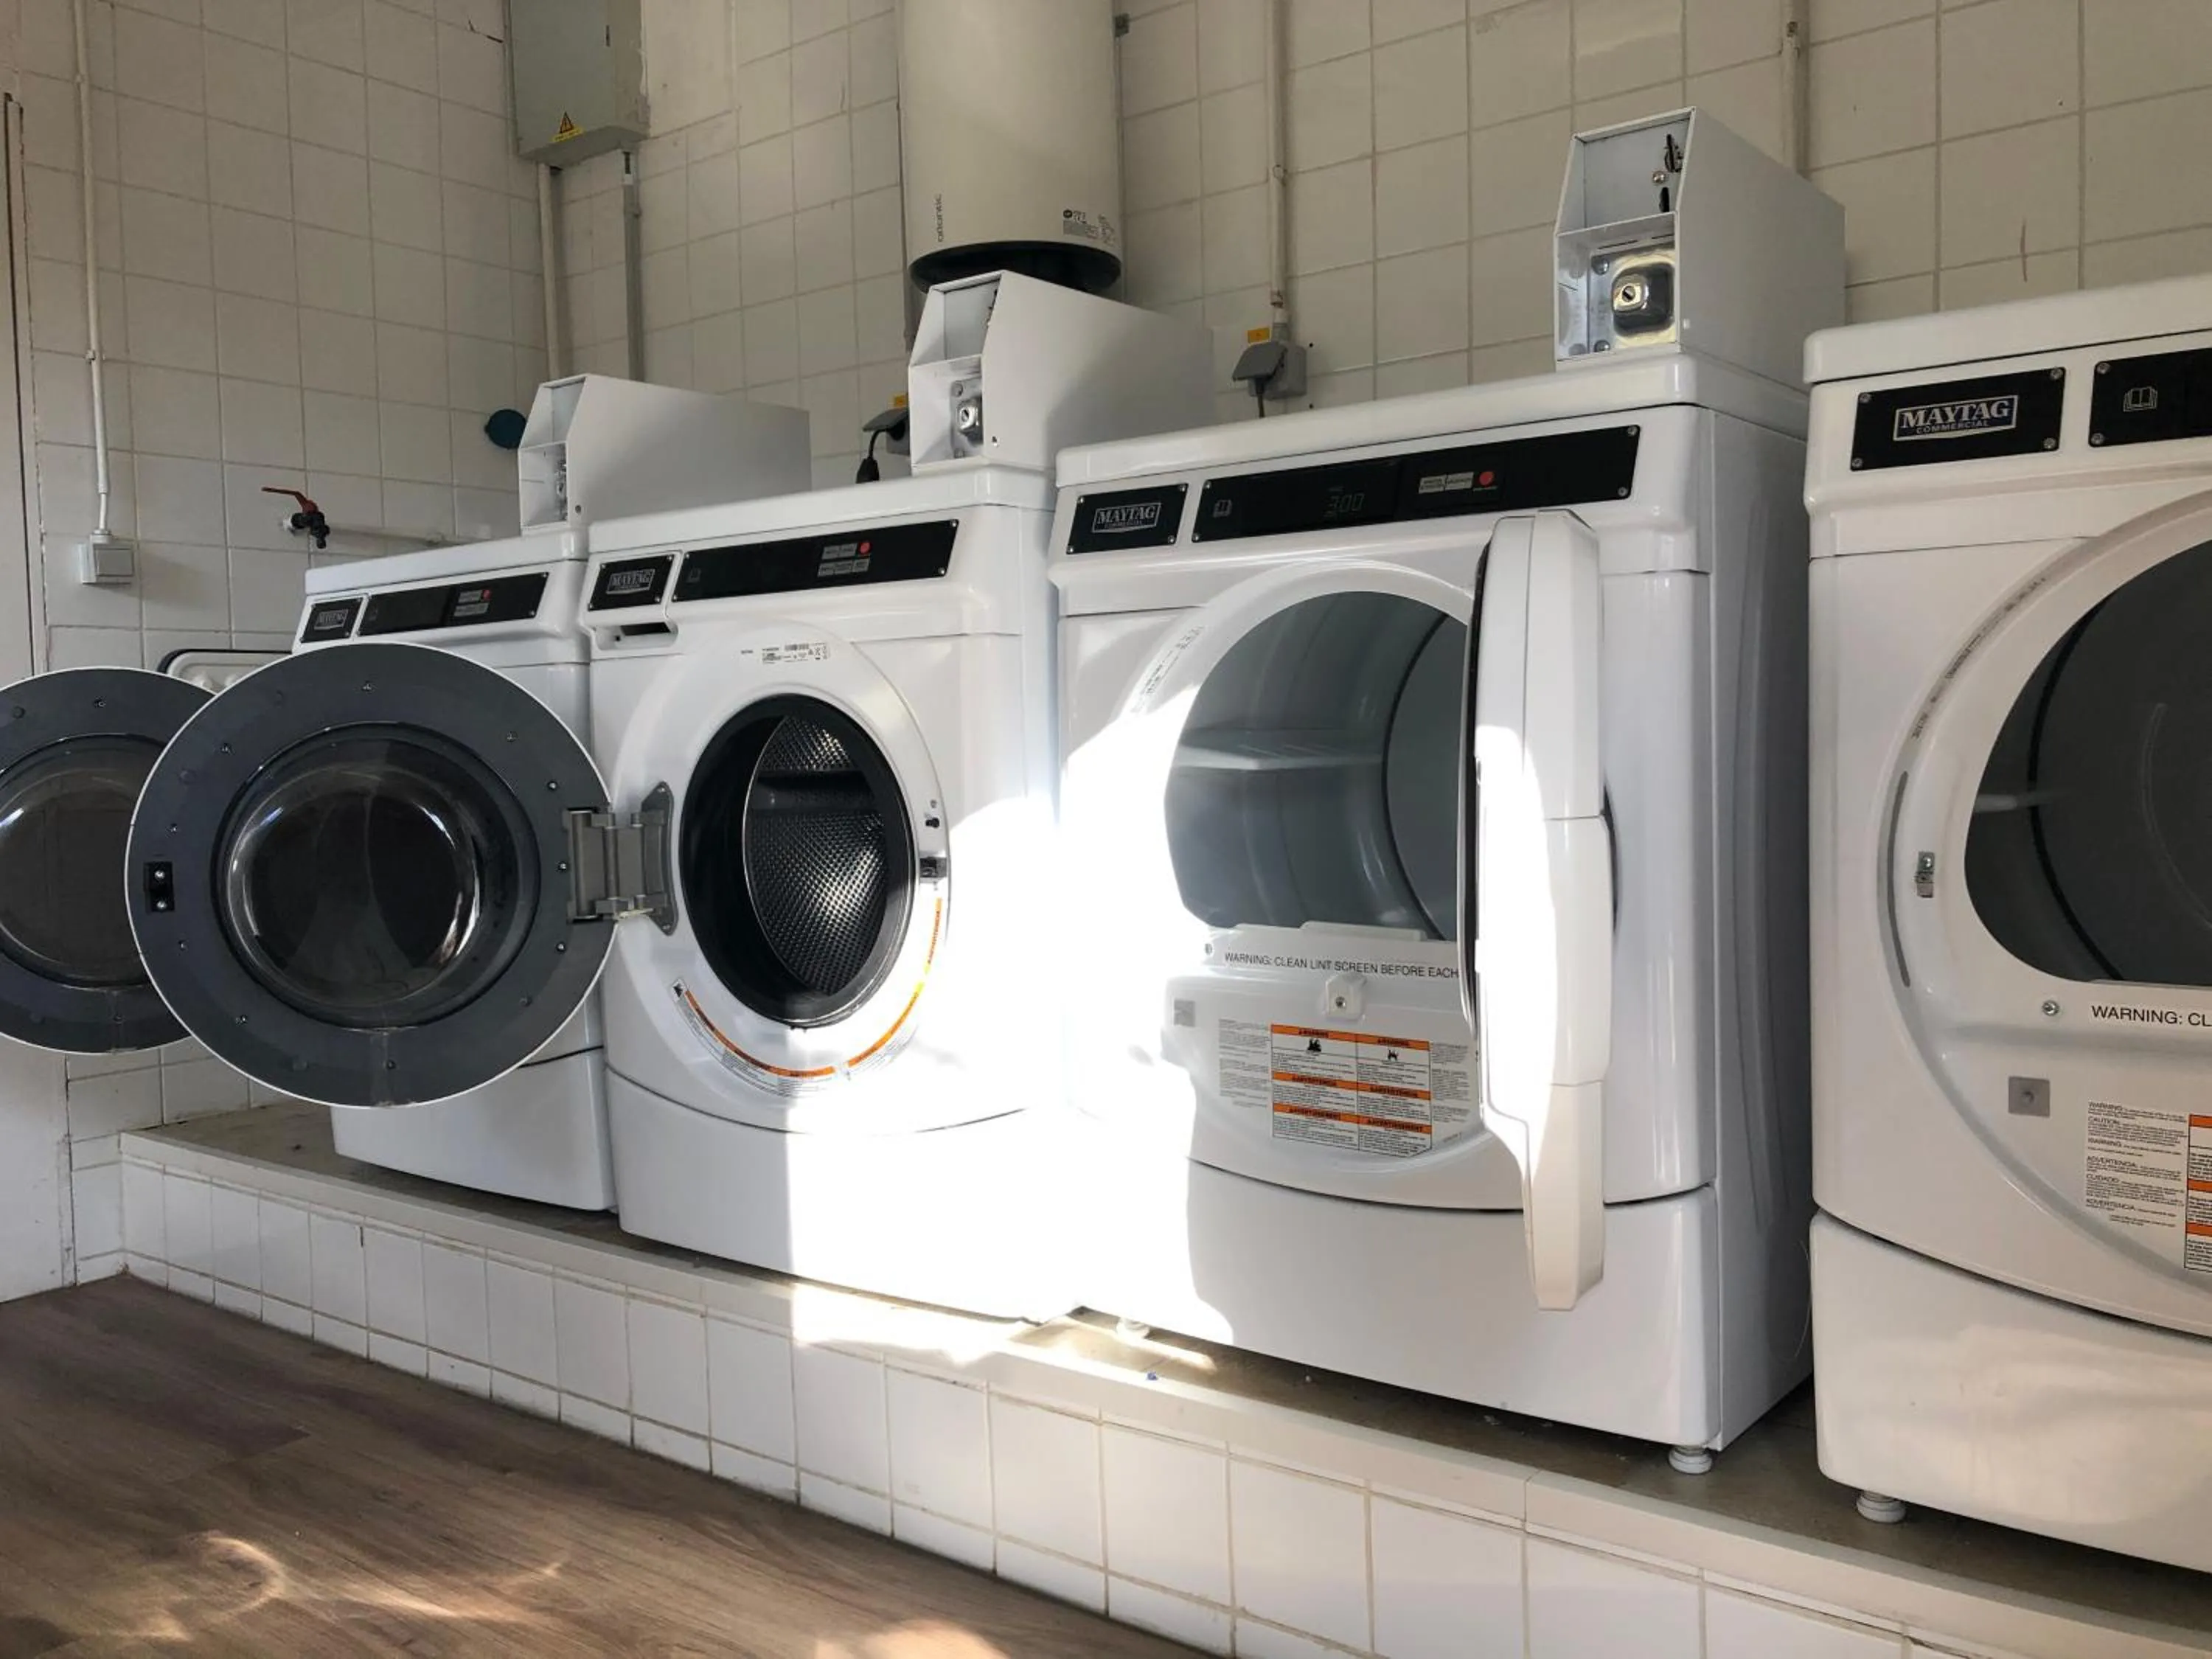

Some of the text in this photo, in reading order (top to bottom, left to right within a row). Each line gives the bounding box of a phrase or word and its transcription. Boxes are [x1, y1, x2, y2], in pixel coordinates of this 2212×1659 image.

[1900, 400, 2011, 428] MAYTAG
[1916, 420, 1990, 434] COMMERCIAL
[1097, 506, 1156, 524] MAYTAG
[1225, 953, 1459, 978] WARNING: CLEAN LINT SCREEN BEFORE EACH
[2091, 1005, 2183, 1025] WARNING:
